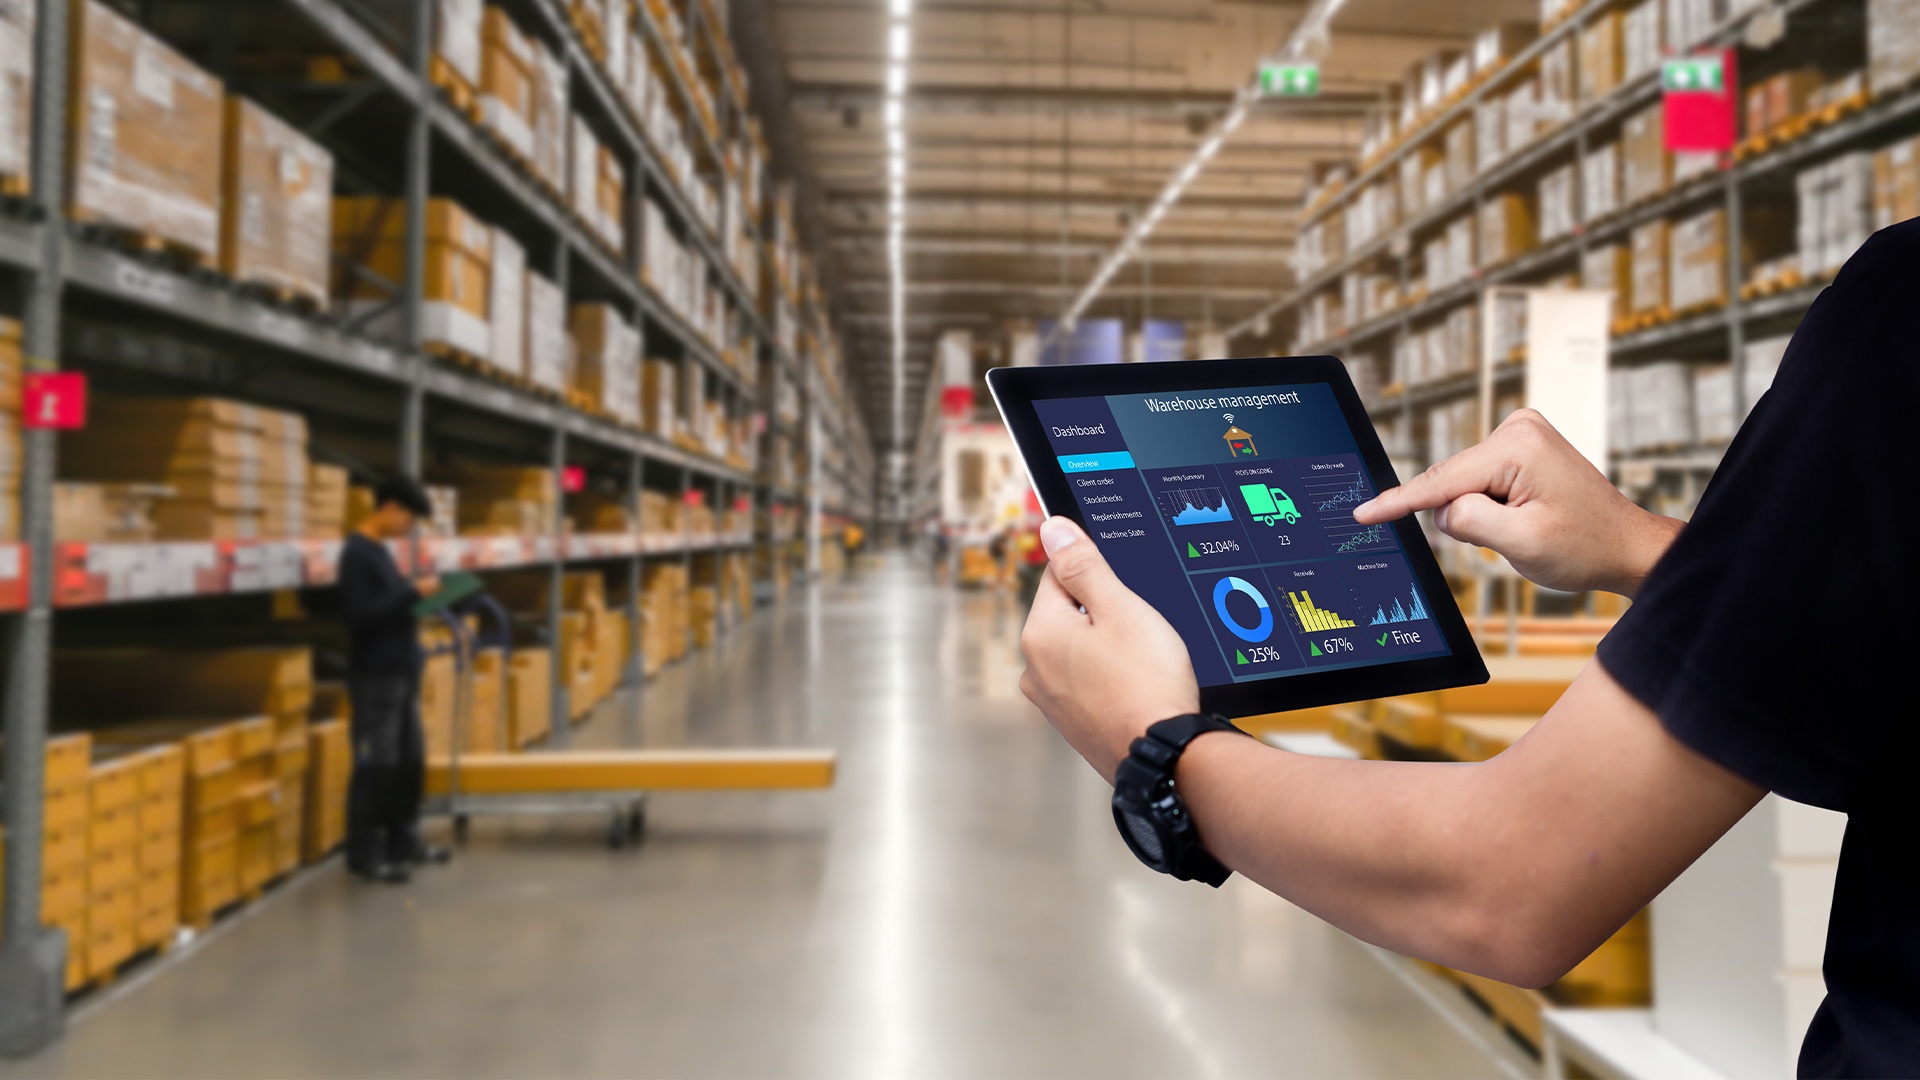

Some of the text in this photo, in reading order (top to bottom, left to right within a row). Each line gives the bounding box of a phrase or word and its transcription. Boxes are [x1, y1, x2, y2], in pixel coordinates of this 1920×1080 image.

[1144, 391, 1301, 412] Warehouse management
[1052, 423, 1106, 437] Dashboard
[1068, 460, 1099, 469] Overview
[1077, 477, 1114, 487] Client order
[1084, 494, 1123, 504] Stockchecks
[1092, 511, 1143, 522] Replenishments
[1100, 528, 1145, 539] Machine State
[1278, 535, 1290, 545] 23
[1200, 540, 1240, 555] 32.04%
[1392, 630, 1421, 645] Fine
[1324, 637, 1354, 654] 67%
[1248, 646, 1280, 663] 25%
